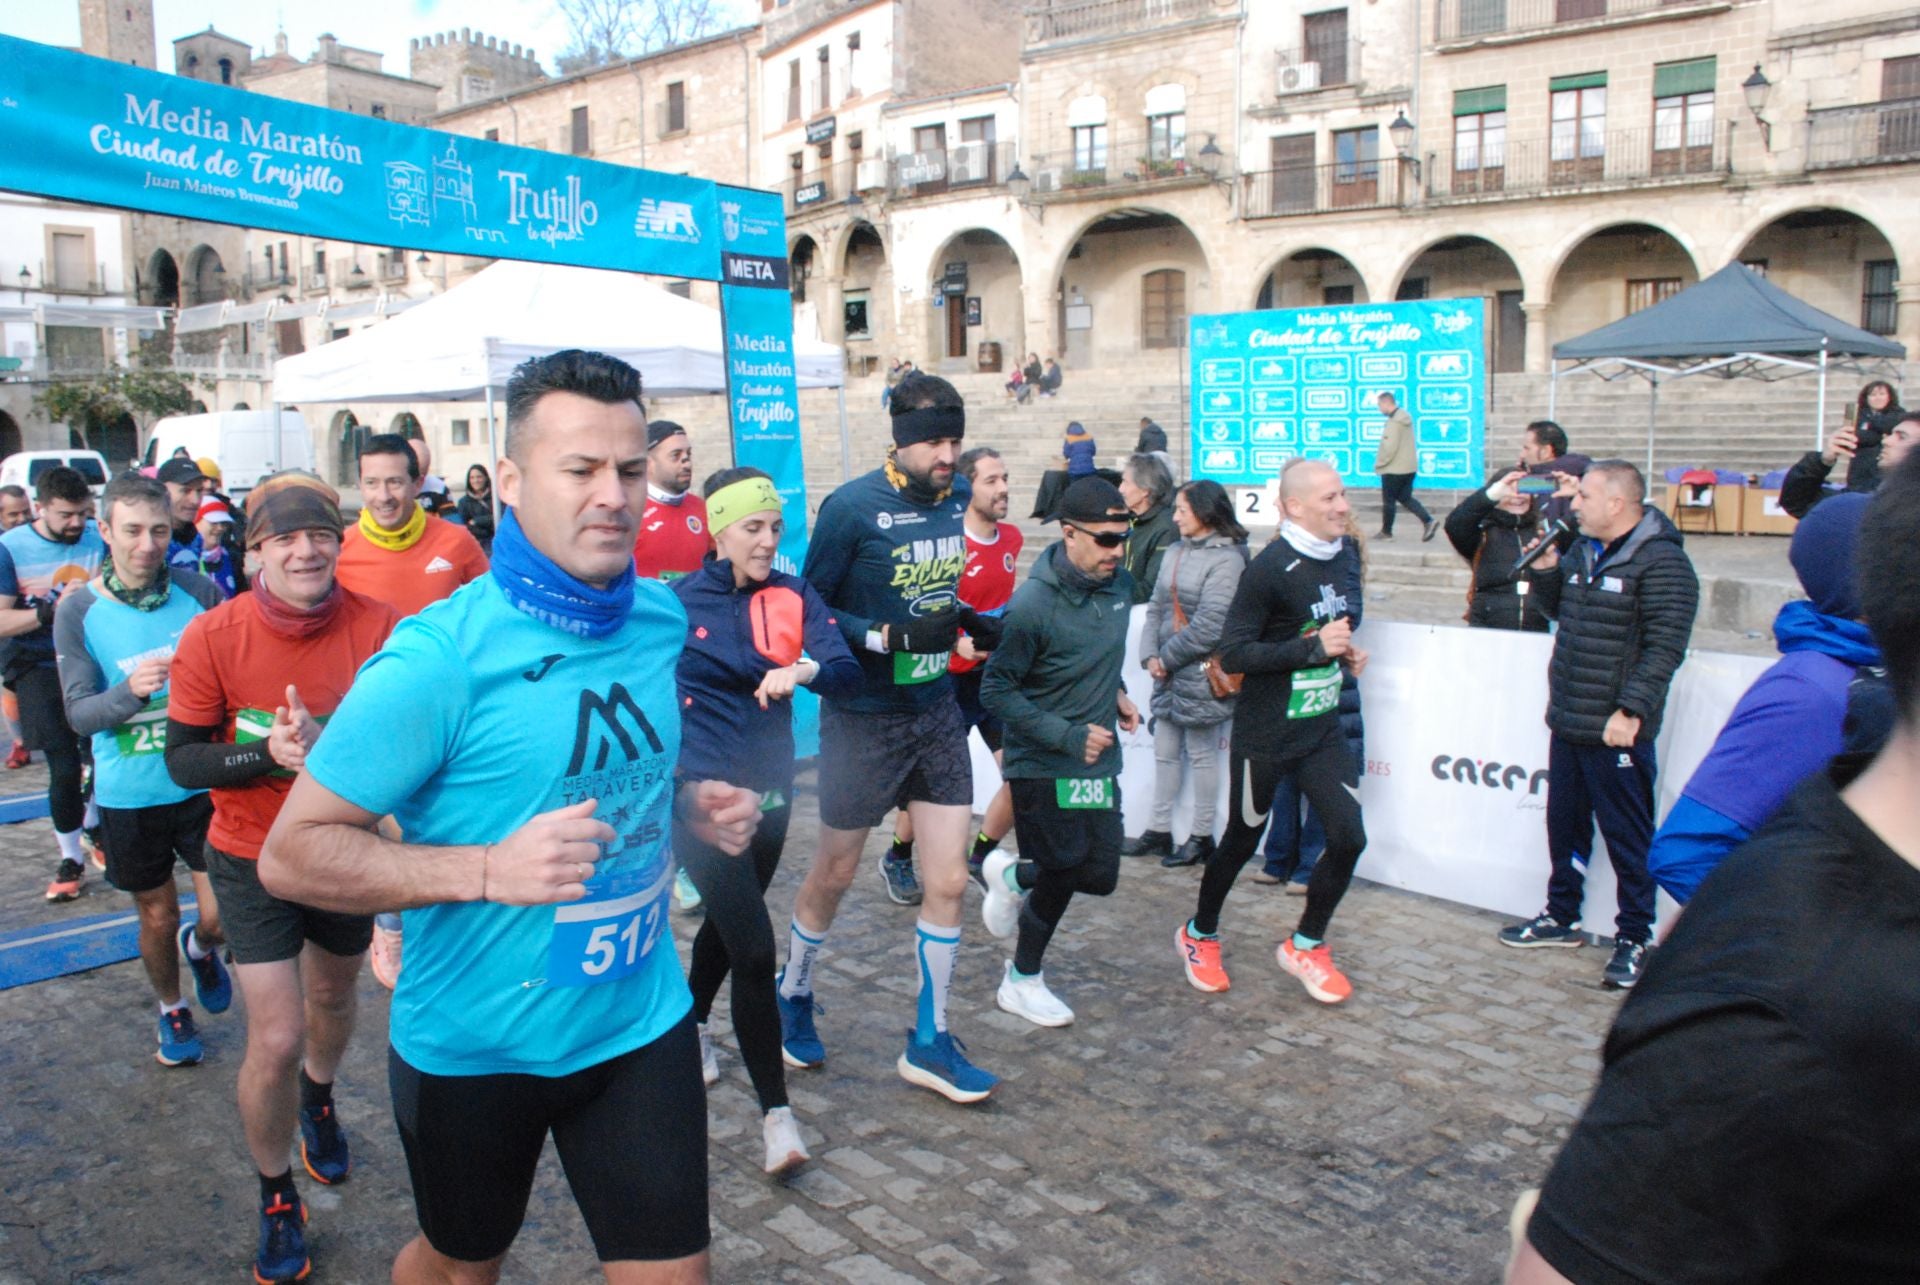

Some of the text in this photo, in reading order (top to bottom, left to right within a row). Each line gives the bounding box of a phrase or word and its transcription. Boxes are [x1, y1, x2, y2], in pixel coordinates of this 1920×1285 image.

[124, 92, 364, 166] Media Maratón
[89, 123, 345, 200] Ciudad de Trujillo
[143, 171, 181, 190] Juan
[183, 177, 237, 200] Mateos
[498, 168, 599, 237] Trujillo
[729, 258, 776, 281] META
[1296, 310, 1394, 327] Media Maratón
[734, 333, 787, 353] Media
[1248, 323, 1422, 349] Ciudad de Trujillo
[733, 359, 792, 377] Maratón
[735, 398, 796, 432] Trujillo
[1246, 492, 1259, 513] 2
[912, 539, 935, 564] NO
[224, 751, 261, 768] KIPSTA
[1069, 778, 1105, 804] 238
[581, 900, 660, 976] 512
